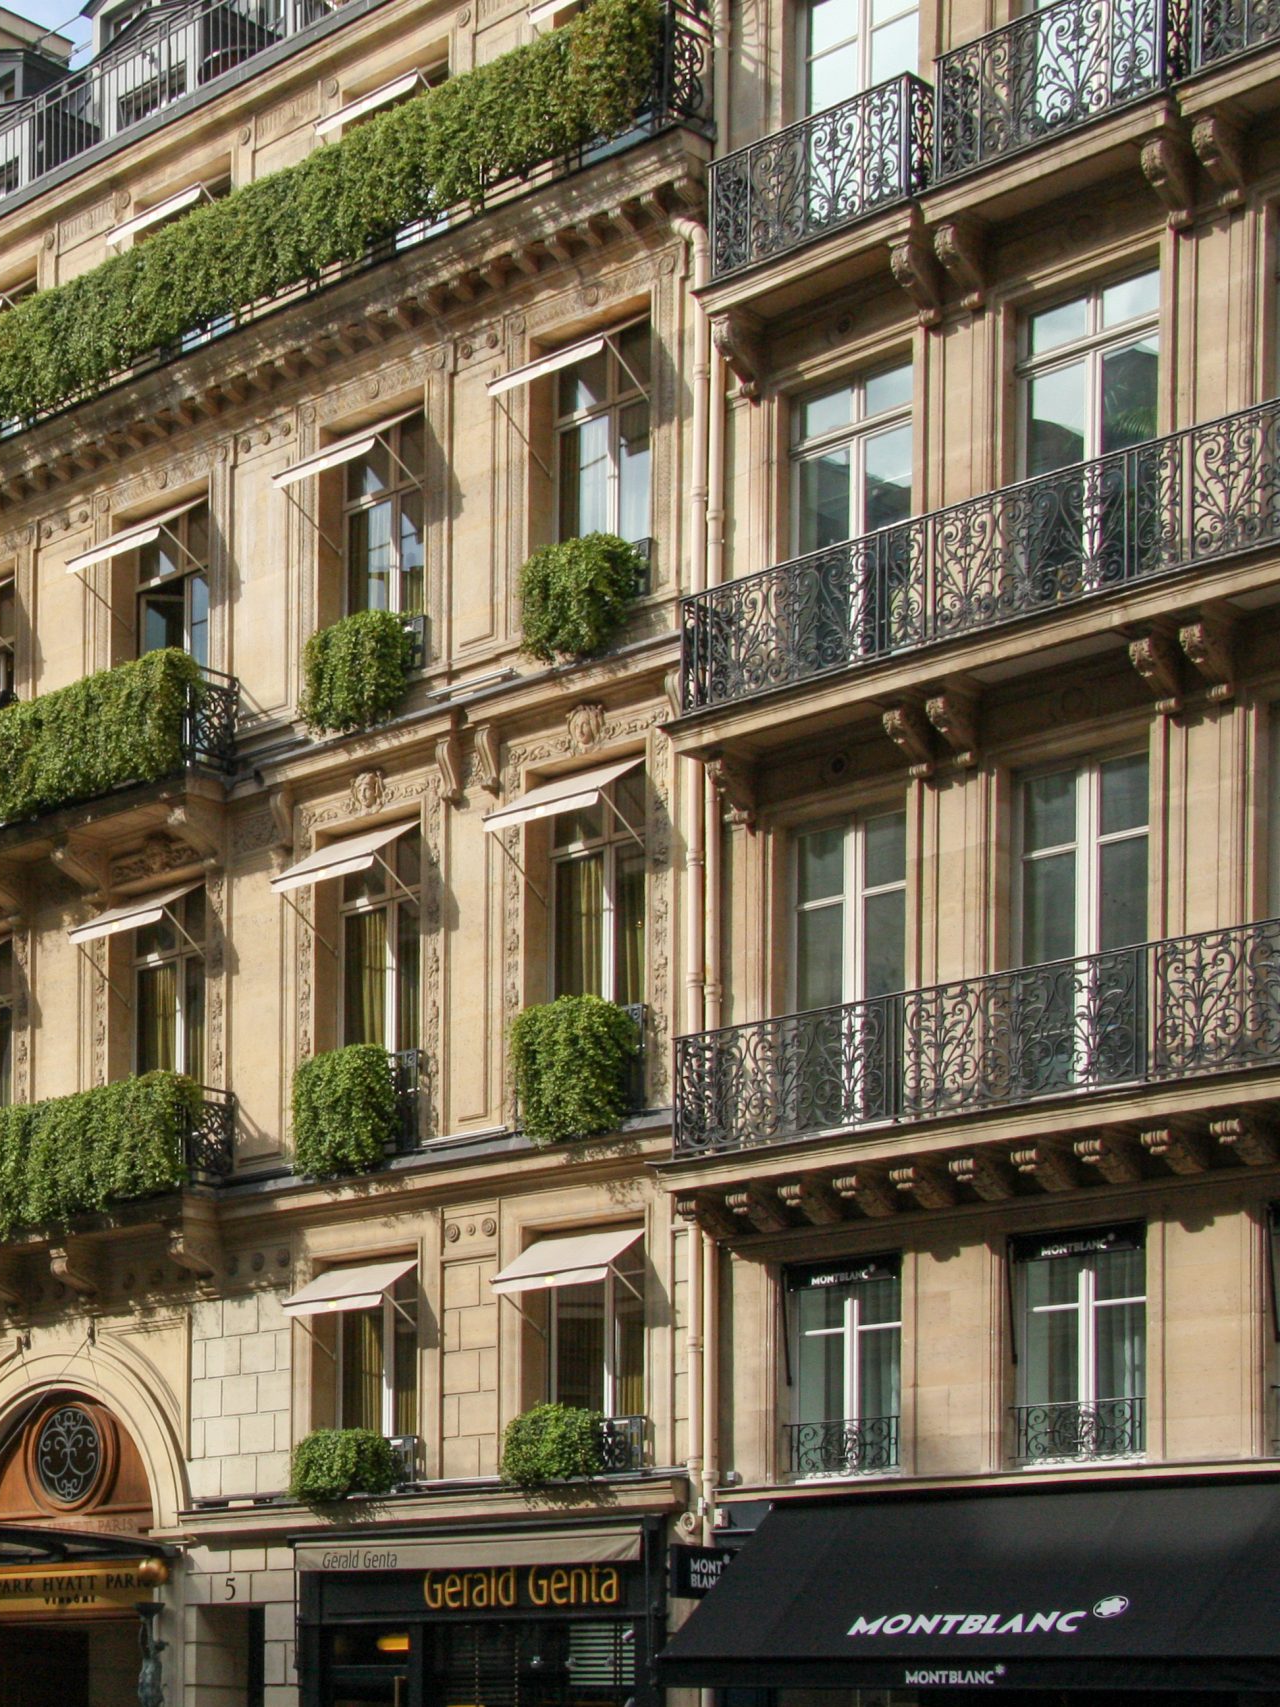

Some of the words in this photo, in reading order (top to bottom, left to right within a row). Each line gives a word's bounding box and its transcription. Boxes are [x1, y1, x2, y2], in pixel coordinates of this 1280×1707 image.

[1041, 1238, 1107, 1257] MONTBLANC
[811, 1269, 869, 1286] MONTBLANC
[363, 1550, 398, 1568] Genta
[690, 1558, 722, 1574] MONT
[43, 1575, 97, 1592] HYATT
[225, 1577, 235, 1600] 5
[528, 1564, 617, 1605] Genta
[690, 1574, 720, 1589] BLAN
[846, 1610, 1087, 1636] MONTBLANC
[905, 1670, 994, 1684] MONTBLANC
